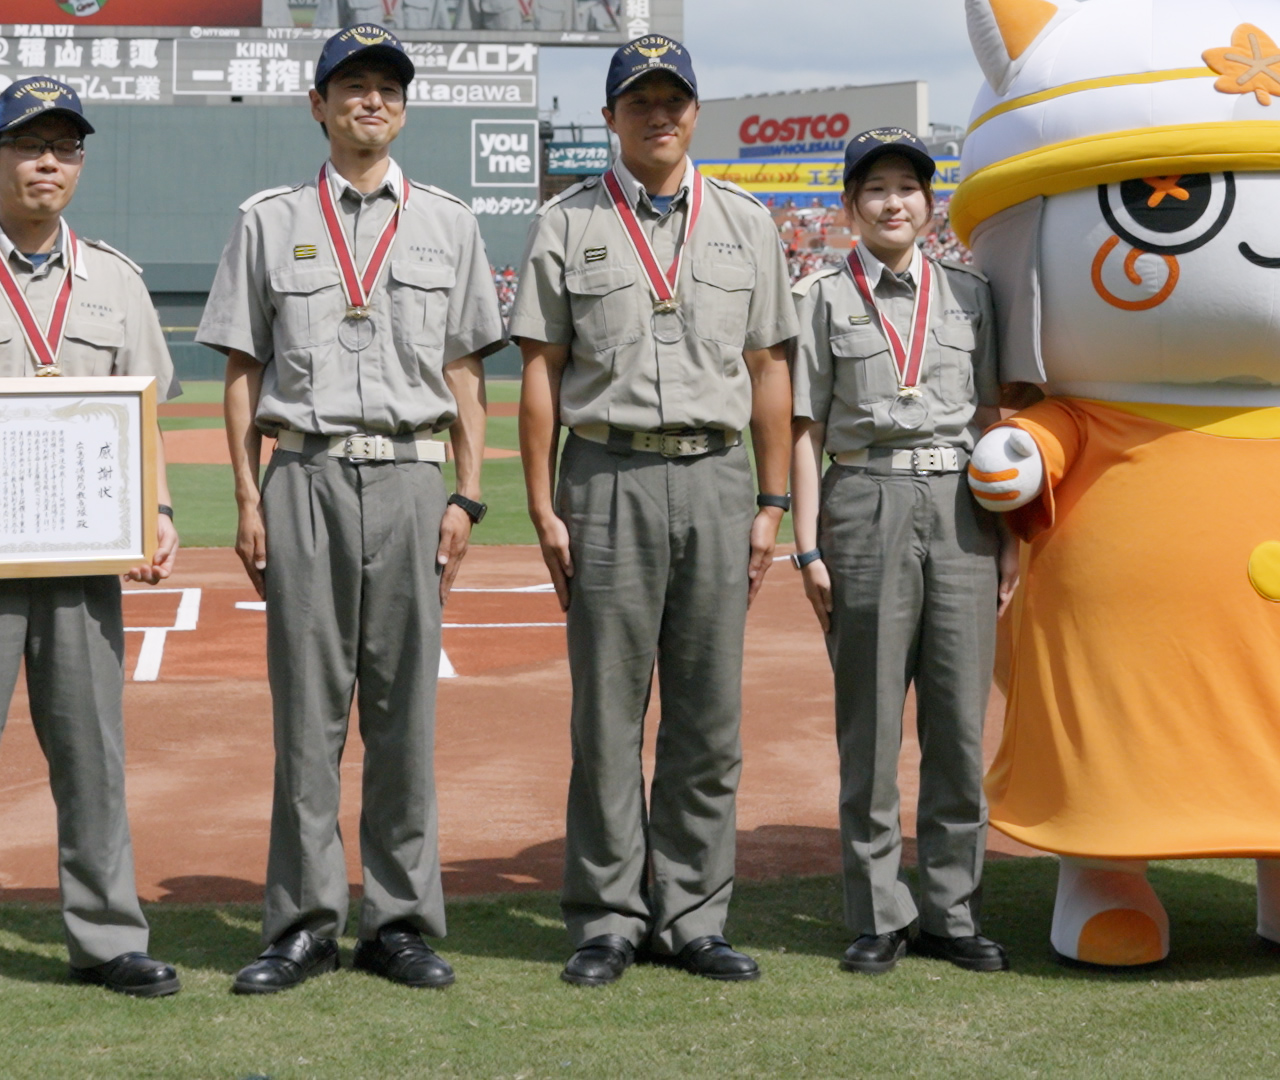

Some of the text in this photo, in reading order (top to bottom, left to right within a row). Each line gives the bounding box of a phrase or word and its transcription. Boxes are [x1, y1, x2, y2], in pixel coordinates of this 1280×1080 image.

[14, 24, 75, 37] MARUI
[18, 38, 159, 69] 福山通運
[236, 43, 288, 58] KIRIN
[448, 42, 538, 71] ムロオ
[623, 38, 682, 56] HIROSHIMA
[408, 80, 520, 104] itagawa
[739, 113, 850, 144] COSTCO
[480, 133, 528, 157] you
[489, 155, 531, 173] me
[472, 196, 537, 216] ゆめタウン
[97, 442, 114, 498] 感謝状
